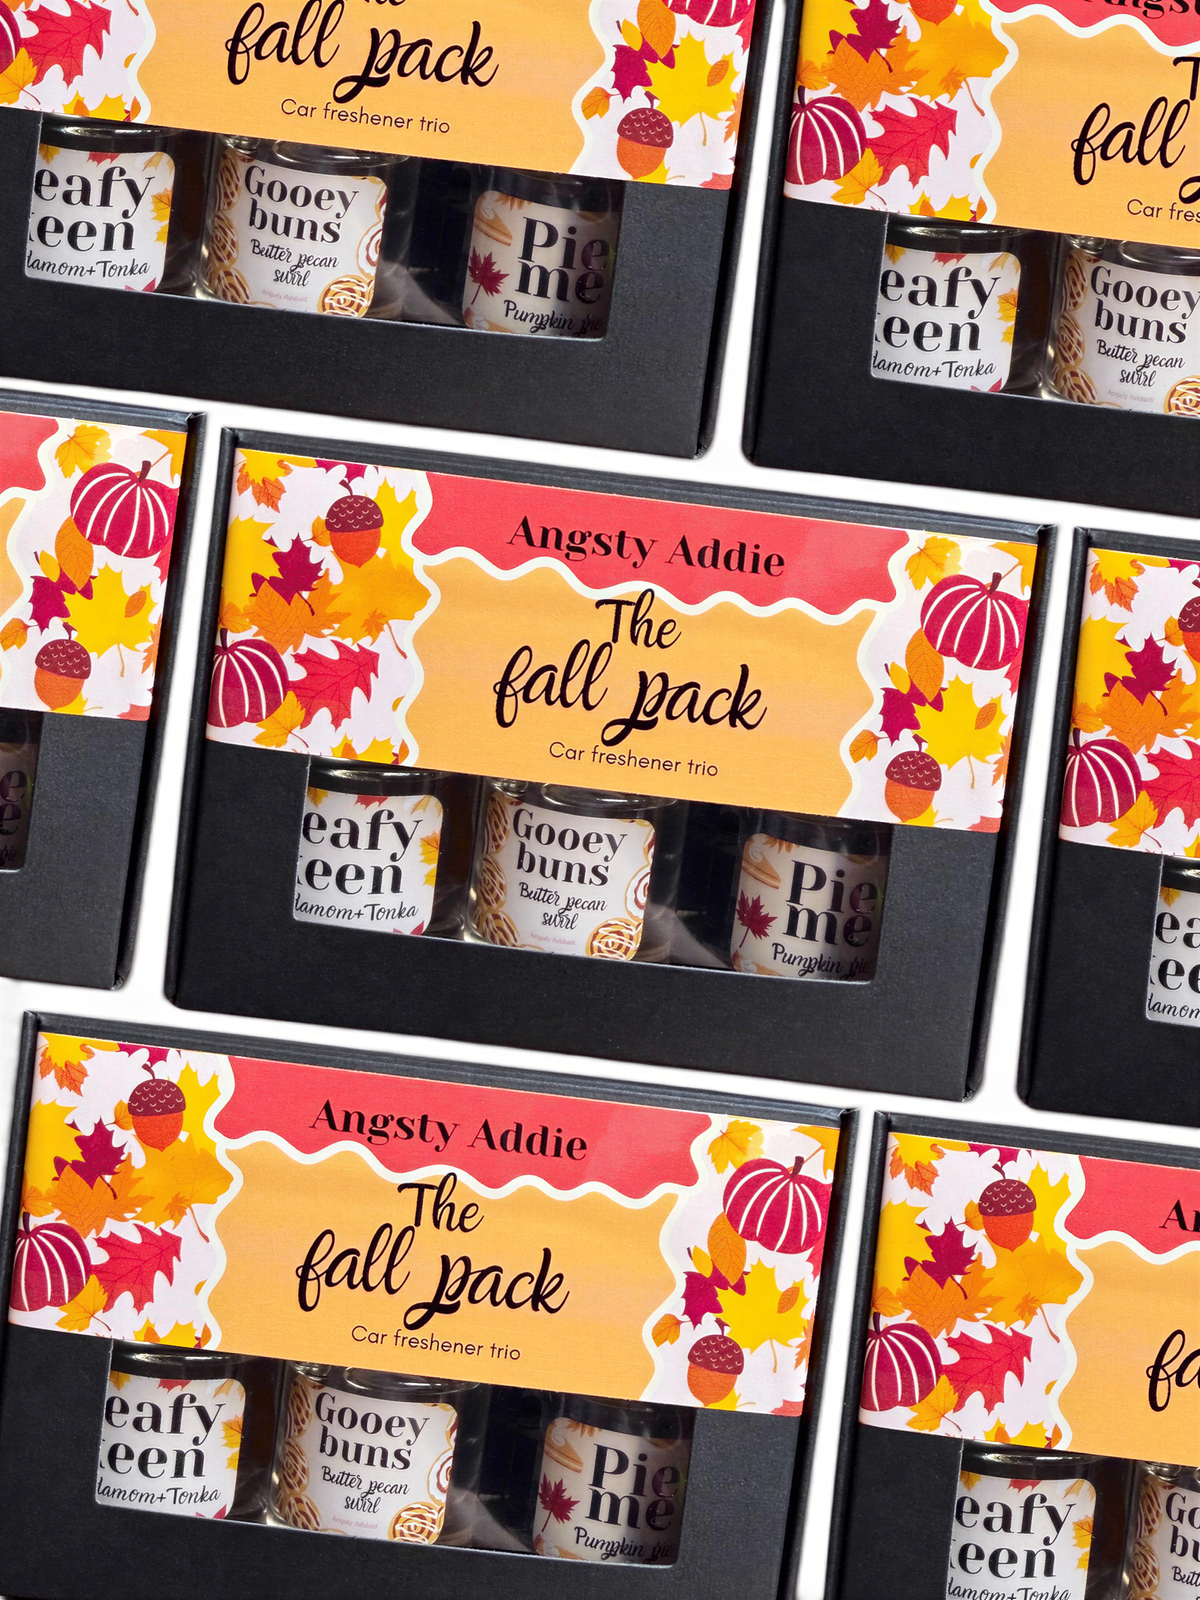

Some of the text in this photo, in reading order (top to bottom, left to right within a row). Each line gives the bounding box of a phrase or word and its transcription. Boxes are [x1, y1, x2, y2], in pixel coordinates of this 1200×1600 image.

[225, 0, 500, 104] fall pack
[282, 98, 450, 133] Car freshener trio
[1071, 96, 1191, 185] fall
[245, 165, 360, 219] Gooey
[1128, 198, 1163, 218] Car
[29, 212, 135, 252] een
[249, 198, 341, 243] buns
[251, 239, 340, 271] Butter pecan
[518, 217, 610, 271] Pie
[274, 270, 311, 286] swirl
[514, 261, 604, 304] me
[1091, 265, 1200, 319] Gooey
[504, 300, 576, 334] Pumpkin
[875, 312, 981, 352] een
[1095, 298, 1187, 343] buns
[1097, 339, 1186, 371] Butter pecan
[1120, 370, 1157, 386] swirl
[506, 515, 785, 577] Angsty Addie
[596, 588, 682, 649] The
[493, 639, 768, 746] fall pack
[550, 741, 718, 776] Car freshener trio
[513, 808, 628, 862] Gooey
[297, 855, 403, 895] een
[517, 841, 609, 886] buns
[519, 882, 608, 914] Butter pecan
[786, 860, 878, 914] Pie
[542, 913, 579, 930] swirl
[782, 904, 872, 947] me
[772, 942, 844, 976] Pumpkin
[308, 1099, 587, 1161] Angsty Addie
[398, 1172, 484, 1233] The
[295, 1223, 570, 1330] fall pack
[352, 1325, 520, 1360] Car freshener trio
[315, 1392, 430, 1446] Gooey
[99, 1439, 205, 1479] een
[319, 1425, 411, 1470] buns
[321, 1466, 410, 1498] Butter pecan
[588, 1444, 680, 1498] Pie
[344, 1497, 381, 1514] swirl
[584, 1488, 674, 1531] me
[574, 1526, 646, 1560] Pumpkin
[950, 1539, 1056, 1579] een
